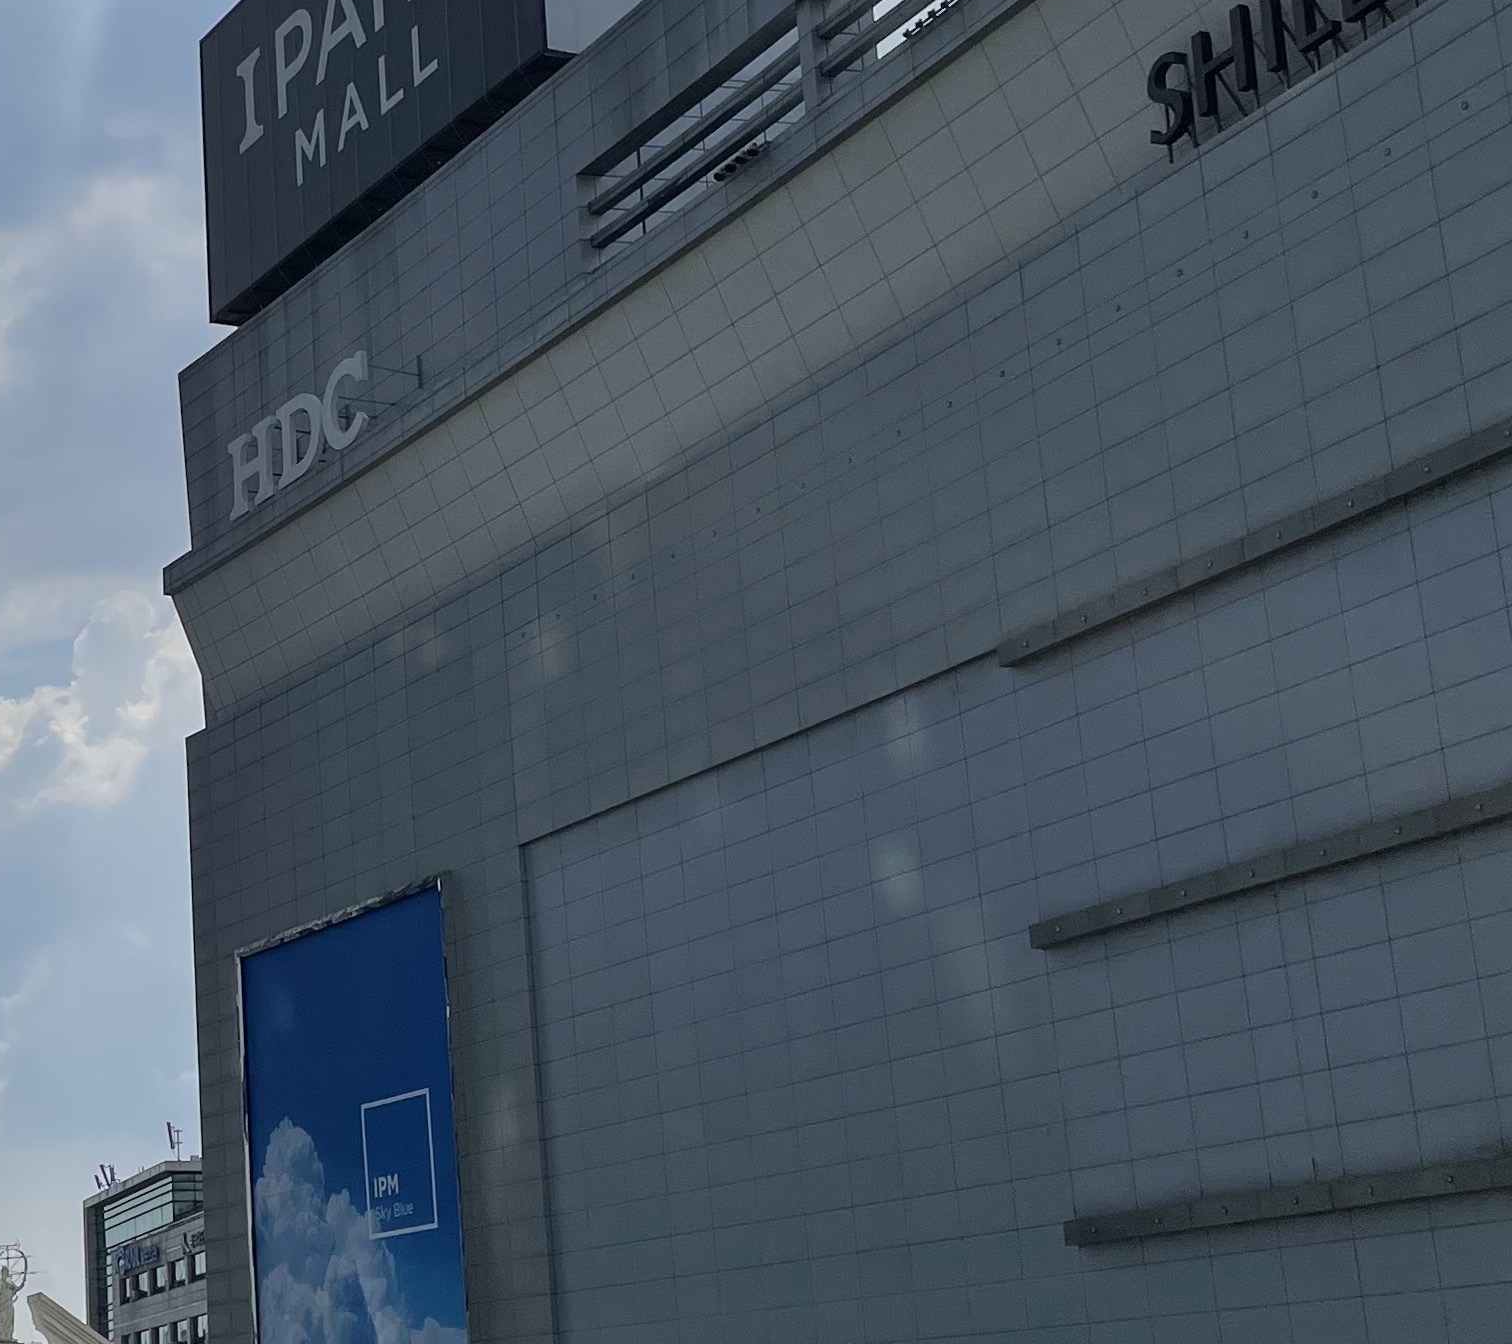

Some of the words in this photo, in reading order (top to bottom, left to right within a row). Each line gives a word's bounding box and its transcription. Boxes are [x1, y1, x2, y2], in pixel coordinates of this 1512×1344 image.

[294, 24, 439, 188] MALL
[227, 350, 369, 522] HDC
[373, 1173, 400, 1199] IPM
[375, 1206, 392, 1222] Sky
[393, 1202, 414, 1218] Blue
